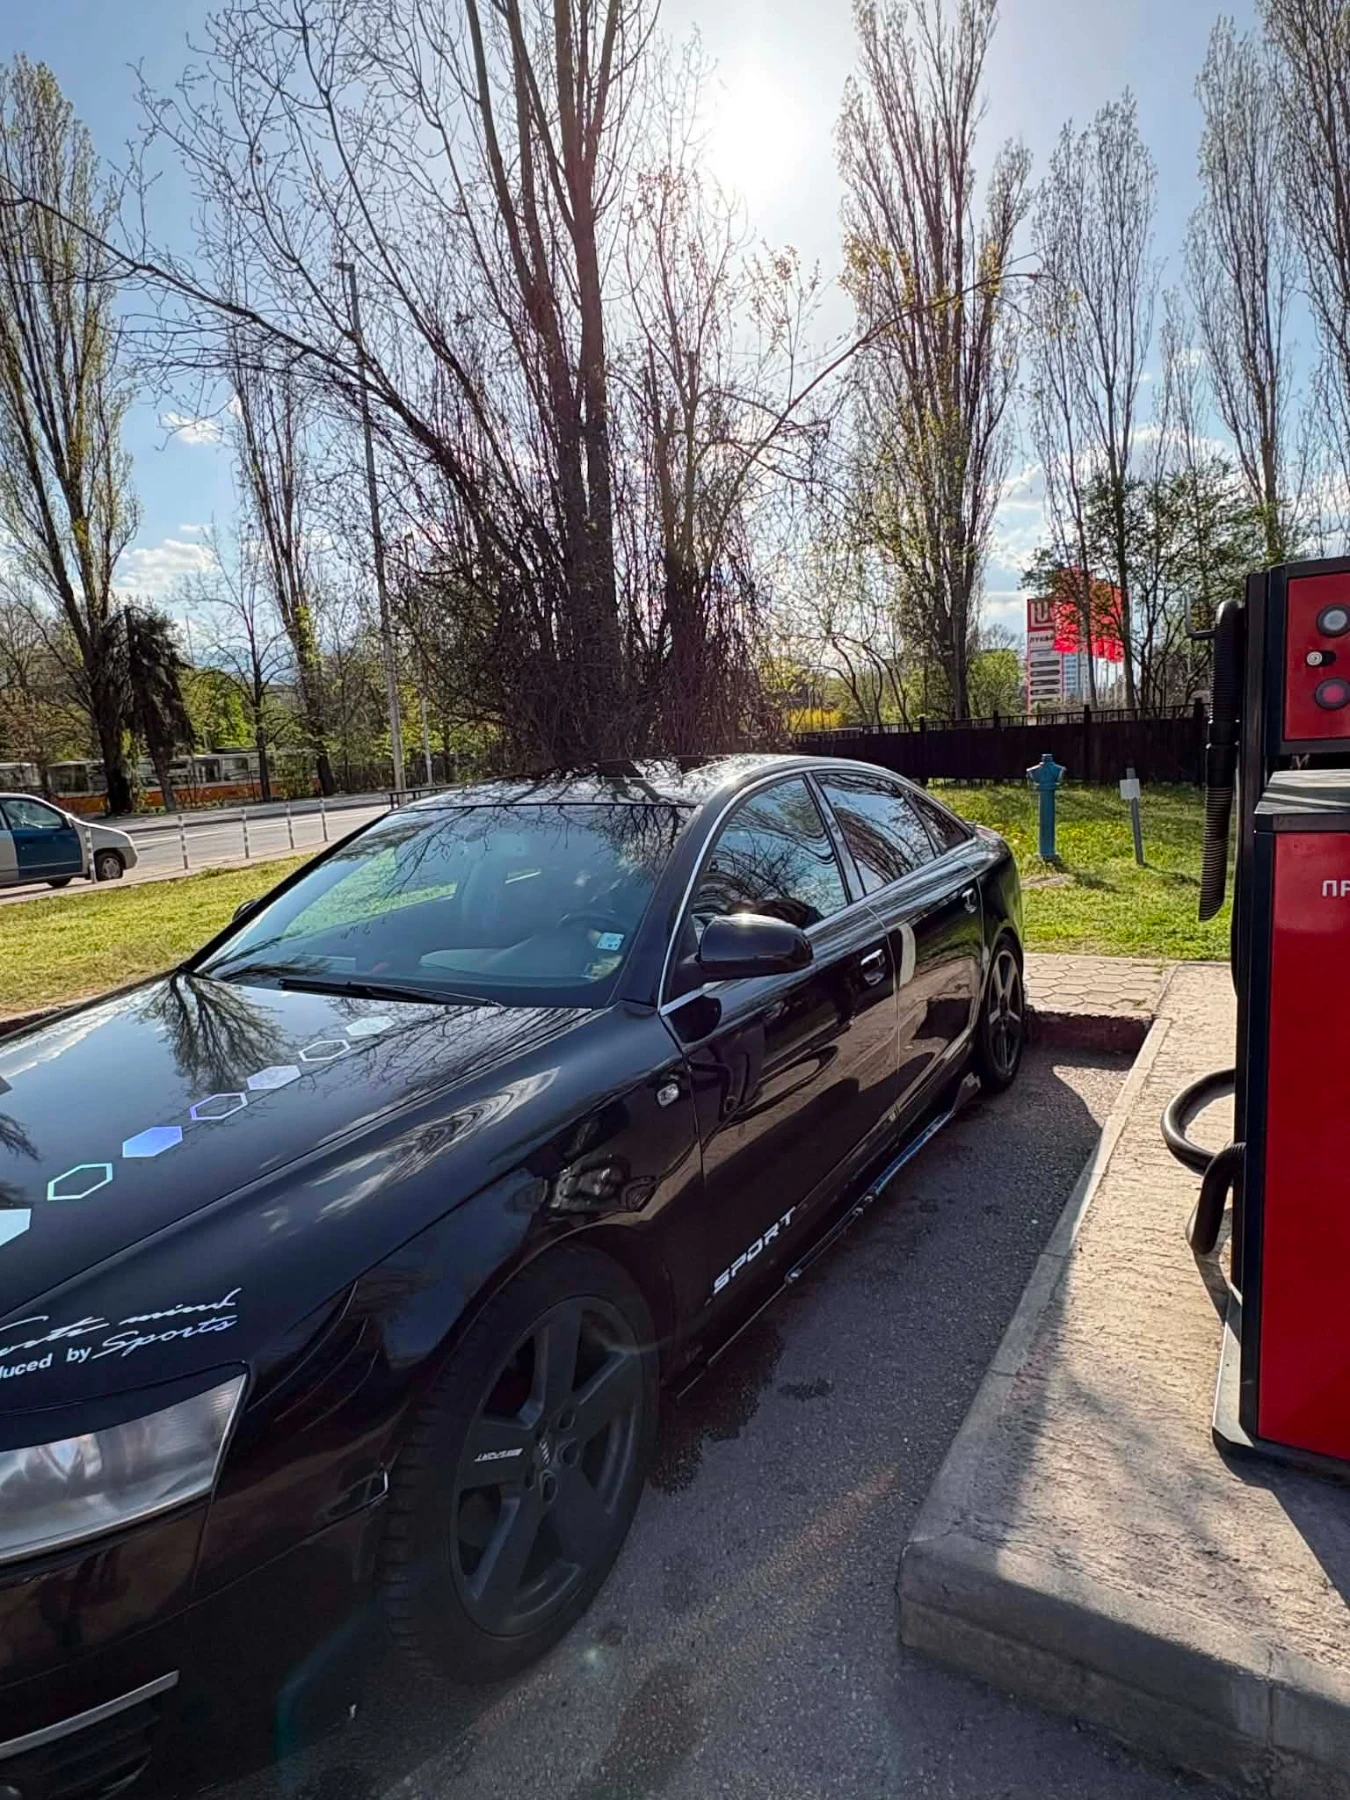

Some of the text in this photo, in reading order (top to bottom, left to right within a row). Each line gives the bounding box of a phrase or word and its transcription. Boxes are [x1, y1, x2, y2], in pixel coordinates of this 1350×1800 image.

[713, 1206, 796, 1294] SPORT
[118, 1288, 242, 1326] mind
[65, 1346, 92, 1363] by
[91, 1315, 238, 1359] Sports
